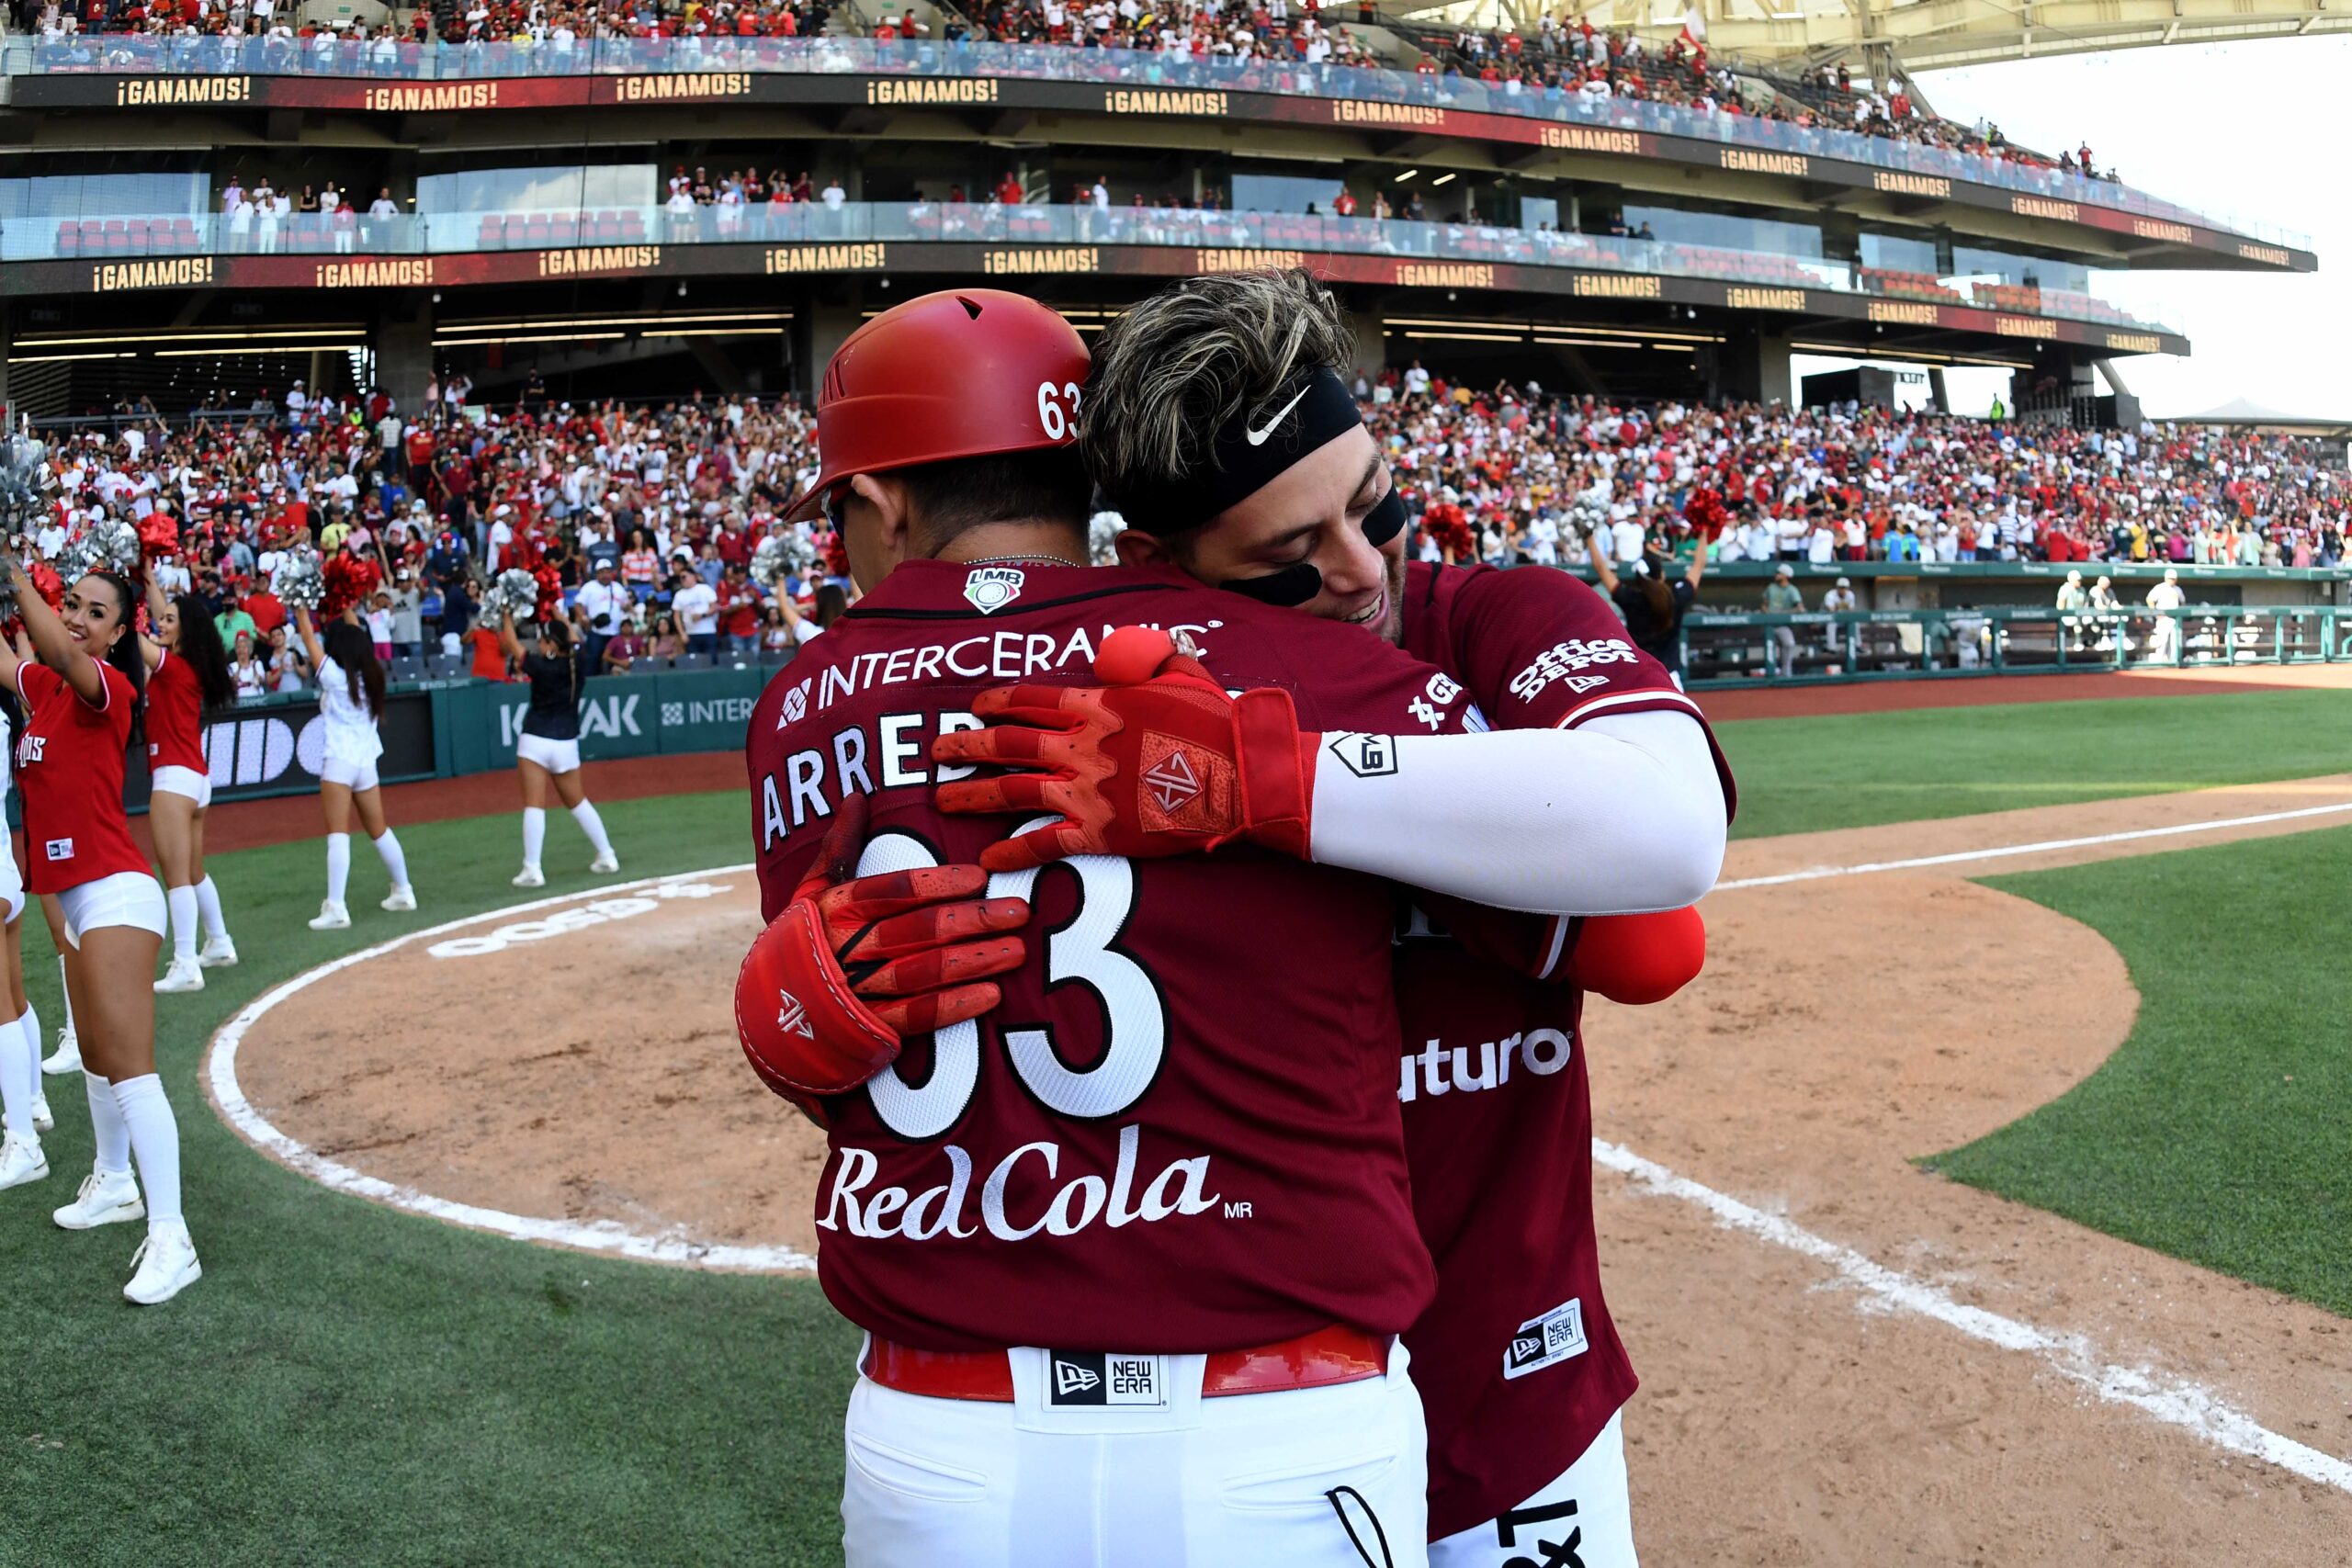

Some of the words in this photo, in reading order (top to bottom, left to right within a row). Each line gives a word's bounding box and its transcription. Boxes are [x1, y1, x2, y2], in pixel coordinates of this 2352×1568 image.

[119, 76, 250, 106] ¡GANAMOS!
[366, 83, 497, 110] ¡GANAMOS!
[617, 75, 750, 101] ¡GANAMOS!
[868, 79, 997, 104] ¡GANAMOS!
[1106, 92, 1227, 114] ¡GANAMOS!
[1333, 100, 1445, 125] ¡GANAMOS!
[1541, 128, 1640, 153] ¡GANAMOS!
[1721, 149, 1808, 175] ¡GANAMOS!
[1874, 172, 1951, 197] ¡GANAMOS!
[2012, 197, 2079, 221] ¡GANAMOS!
[2134, 220, 2192, 243] ¡GANAMOS!
[94, 257, 212, 291] ¡GANAMOS!
[317, 259, 433, 287] ¡GANAMOS!
[539, 248, 660, 276] ¡GANAMOS!
[766, 243, 885, 274] ¡GANAMOS!
[985, 248, 1098, 273] ¡GANAMOS!
[1197, 250, 1304, 274] ¡GANAMOS!
[1396, 265, 1494, 288] ¡GANAMOS!
[1574, 276, 1660, 297] ¡GANAMOS!
[1727, 288, 1804, 310] ¡GANAMOS!
[1869, 303, 1938, 324] ¡GANAMOS!
[1996, 318, 2057, 338] ¡GANAMOS!
[1037, 381, 1081, 440] 63
[969, 570, 1022, 585] LMB
[817, 623, 1209, 711] INTERCERAC
[1510, 638, 1633, 694] Office
[1518, 649, 1640, 705] DEPOT
[500, 694, 641, 746] KAK
[1224, 1201, 1252, 1219] MR
[1547, 1316, 1571, 1337] NEW
[1548, 1327, 1574, 1348] ERA
[1113, 1360, 1151, 1377] NEW
[1113, 1378, 1152, 1393] ERA
